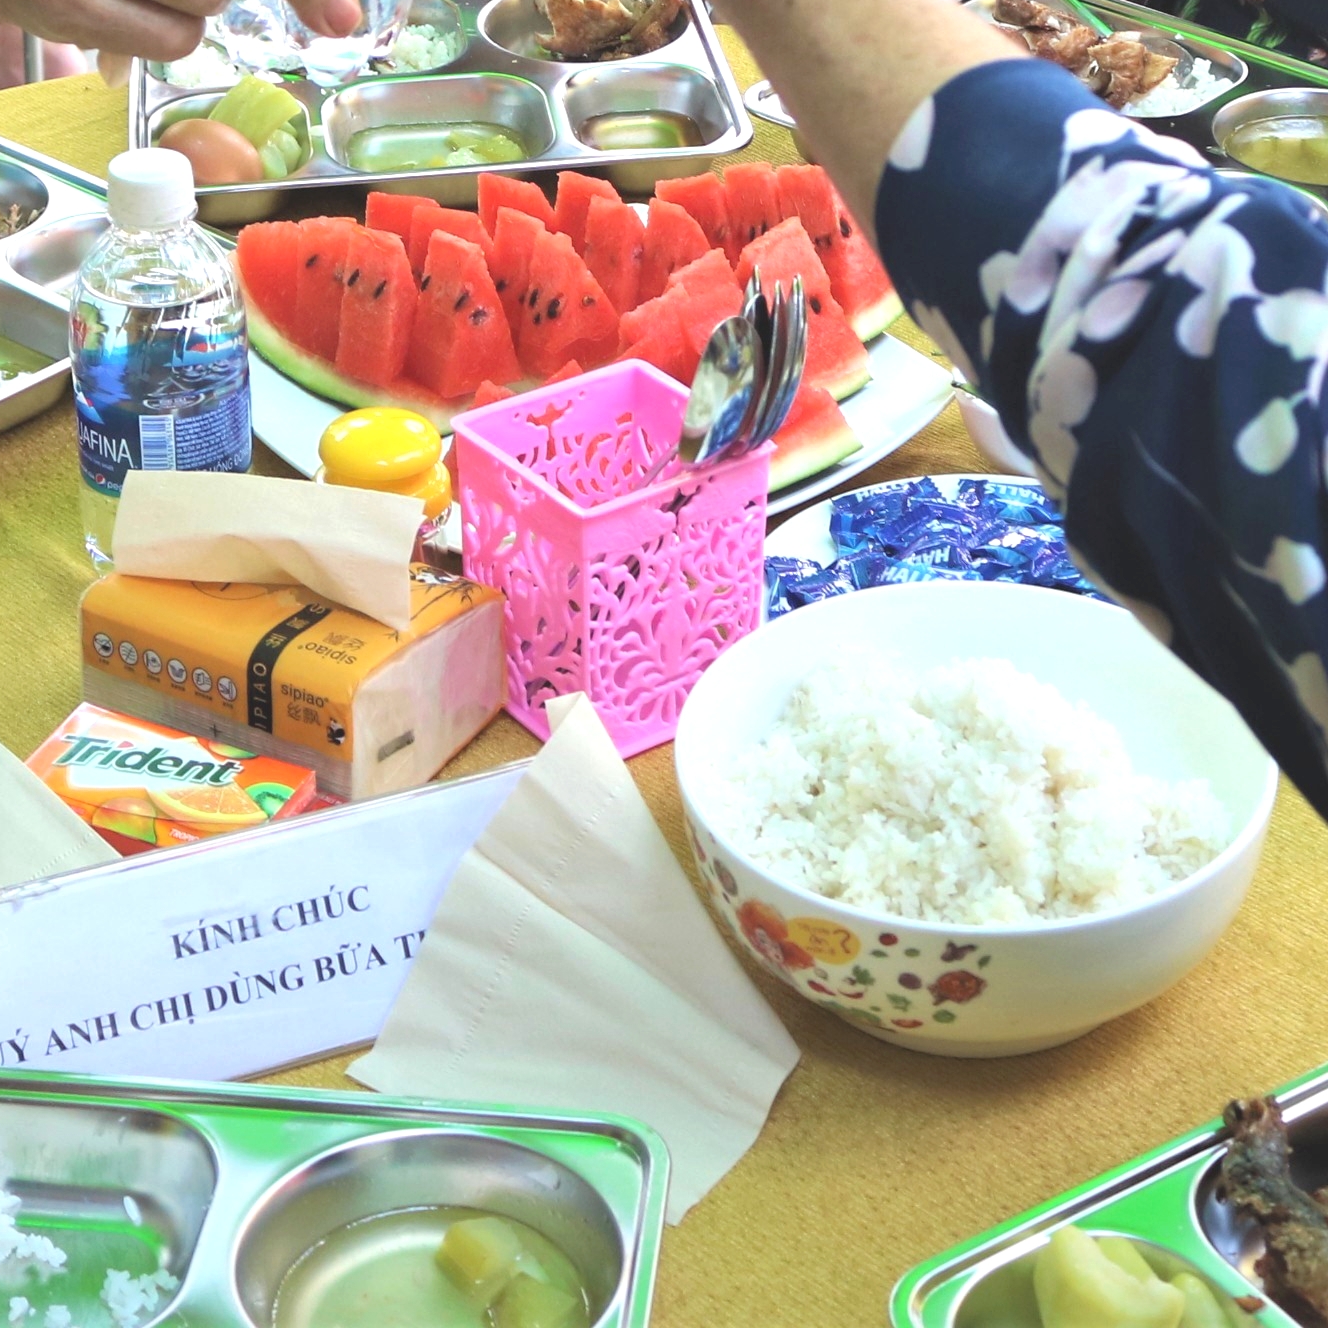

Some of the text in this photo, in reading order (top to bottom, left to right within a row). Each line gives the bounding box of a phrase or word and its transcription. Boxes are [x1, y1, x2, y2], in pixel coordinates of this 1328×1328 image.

[78, 420, 134, 469] UAFINA
[53, 734, 244, 786] Trident
[170, 884, 371, 960] KÍNH CHÚC
[44, 1012, 120, 1056] ANH
[129, 991, 196, 1032] CHỊ
[204, 962, 305, 1013] DÙNG
[315, 941, 388, 984] BỮA
